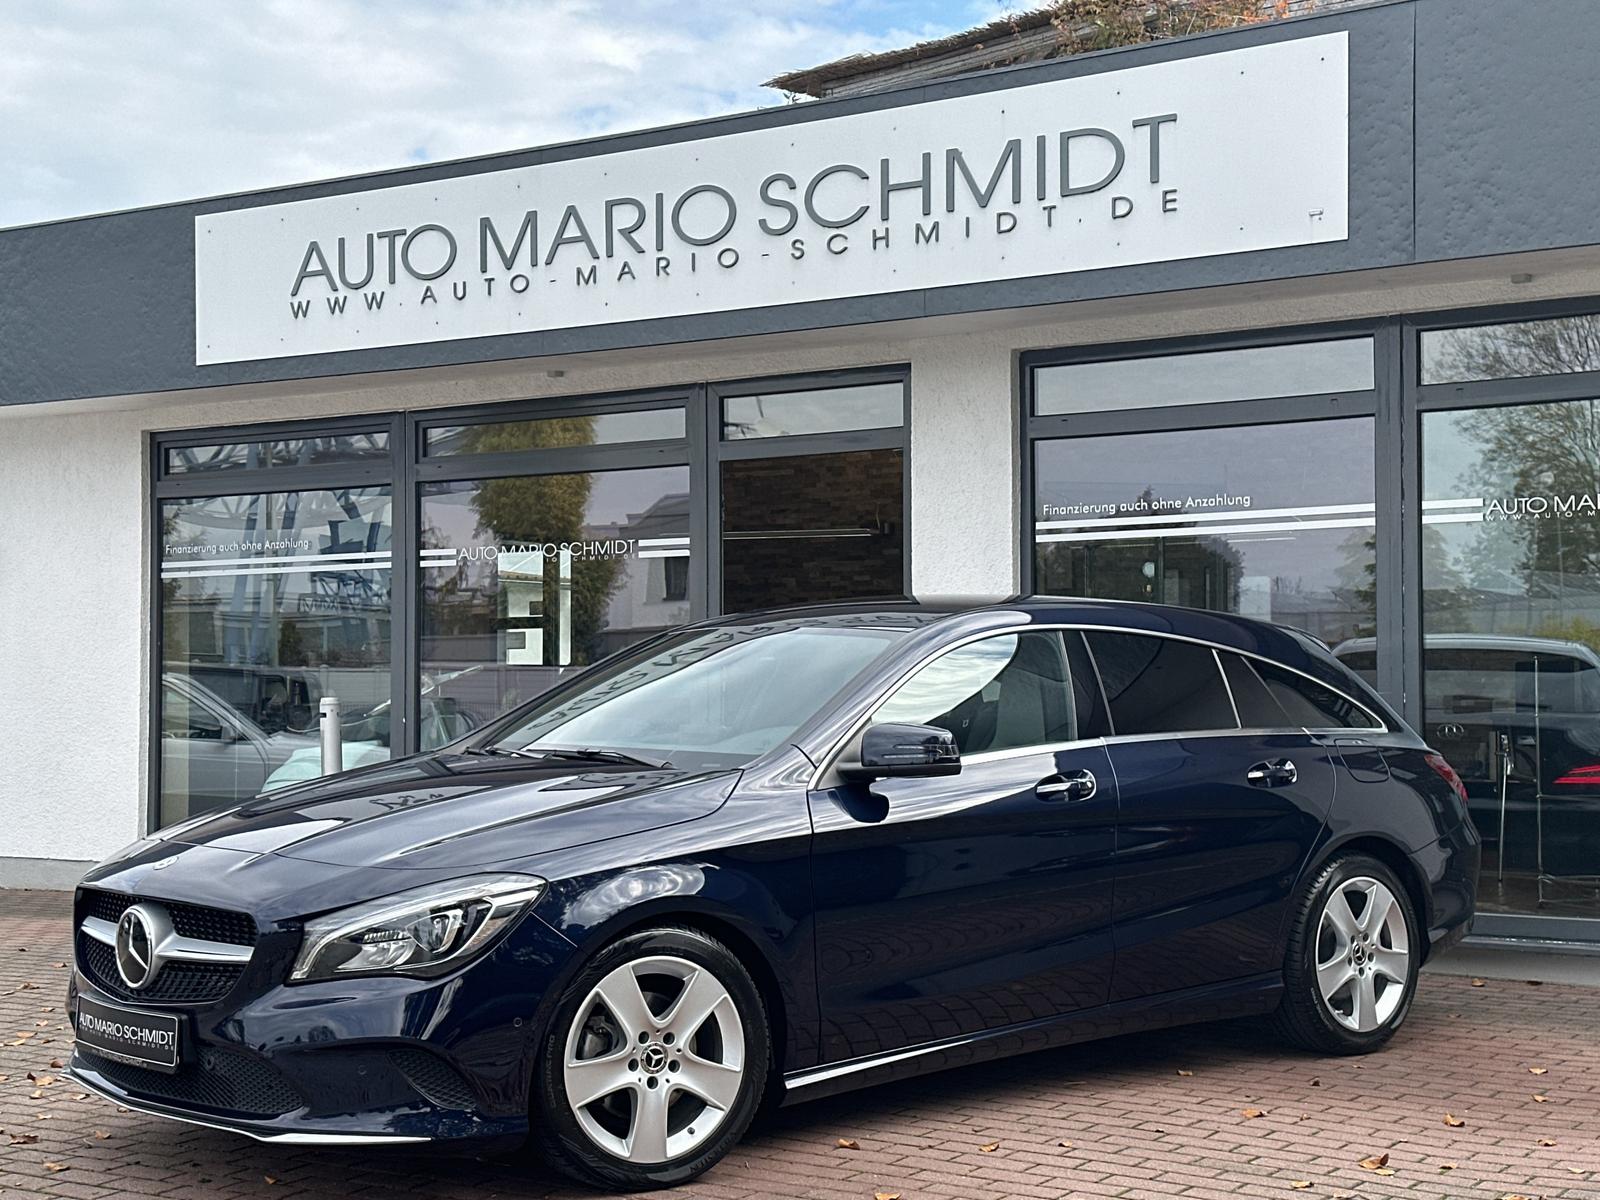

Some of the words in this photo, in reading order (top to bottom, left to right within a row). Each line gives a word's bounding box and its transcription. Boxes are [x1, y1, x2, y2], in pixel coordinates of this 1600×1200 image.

[290, 224, 458, 297] AUTO
[479, 185, 738, 274] MARIO
[757, 112, 1178, 236] SCHMIDT
[1043, 502, 1116, 516] Finanzierung
[1120, 499, 1148, 511] auch
[1151, 497, 1182, 510] ohne
[1185, 493, 1251, 508] Anzahlung
[1486, 496, 1548, 515] AUTO
[1553, 493, 1600, 512] MA
[165, 543, 217, 555] Finanzierung
[219, 541, 239, 552] auch
[241, 540, 262, 551] ohne
[264, 537, 309, 550] Anzahlung
[458, 546, 498, 561] AUTO
[560, 539, 636, 556] SCHMIDT
[79, 1012, 95, 1028] AUTO
[94, 1018, 123, 1037] MARIO
[123, 1025, 175, 1046] SCHMIDT
